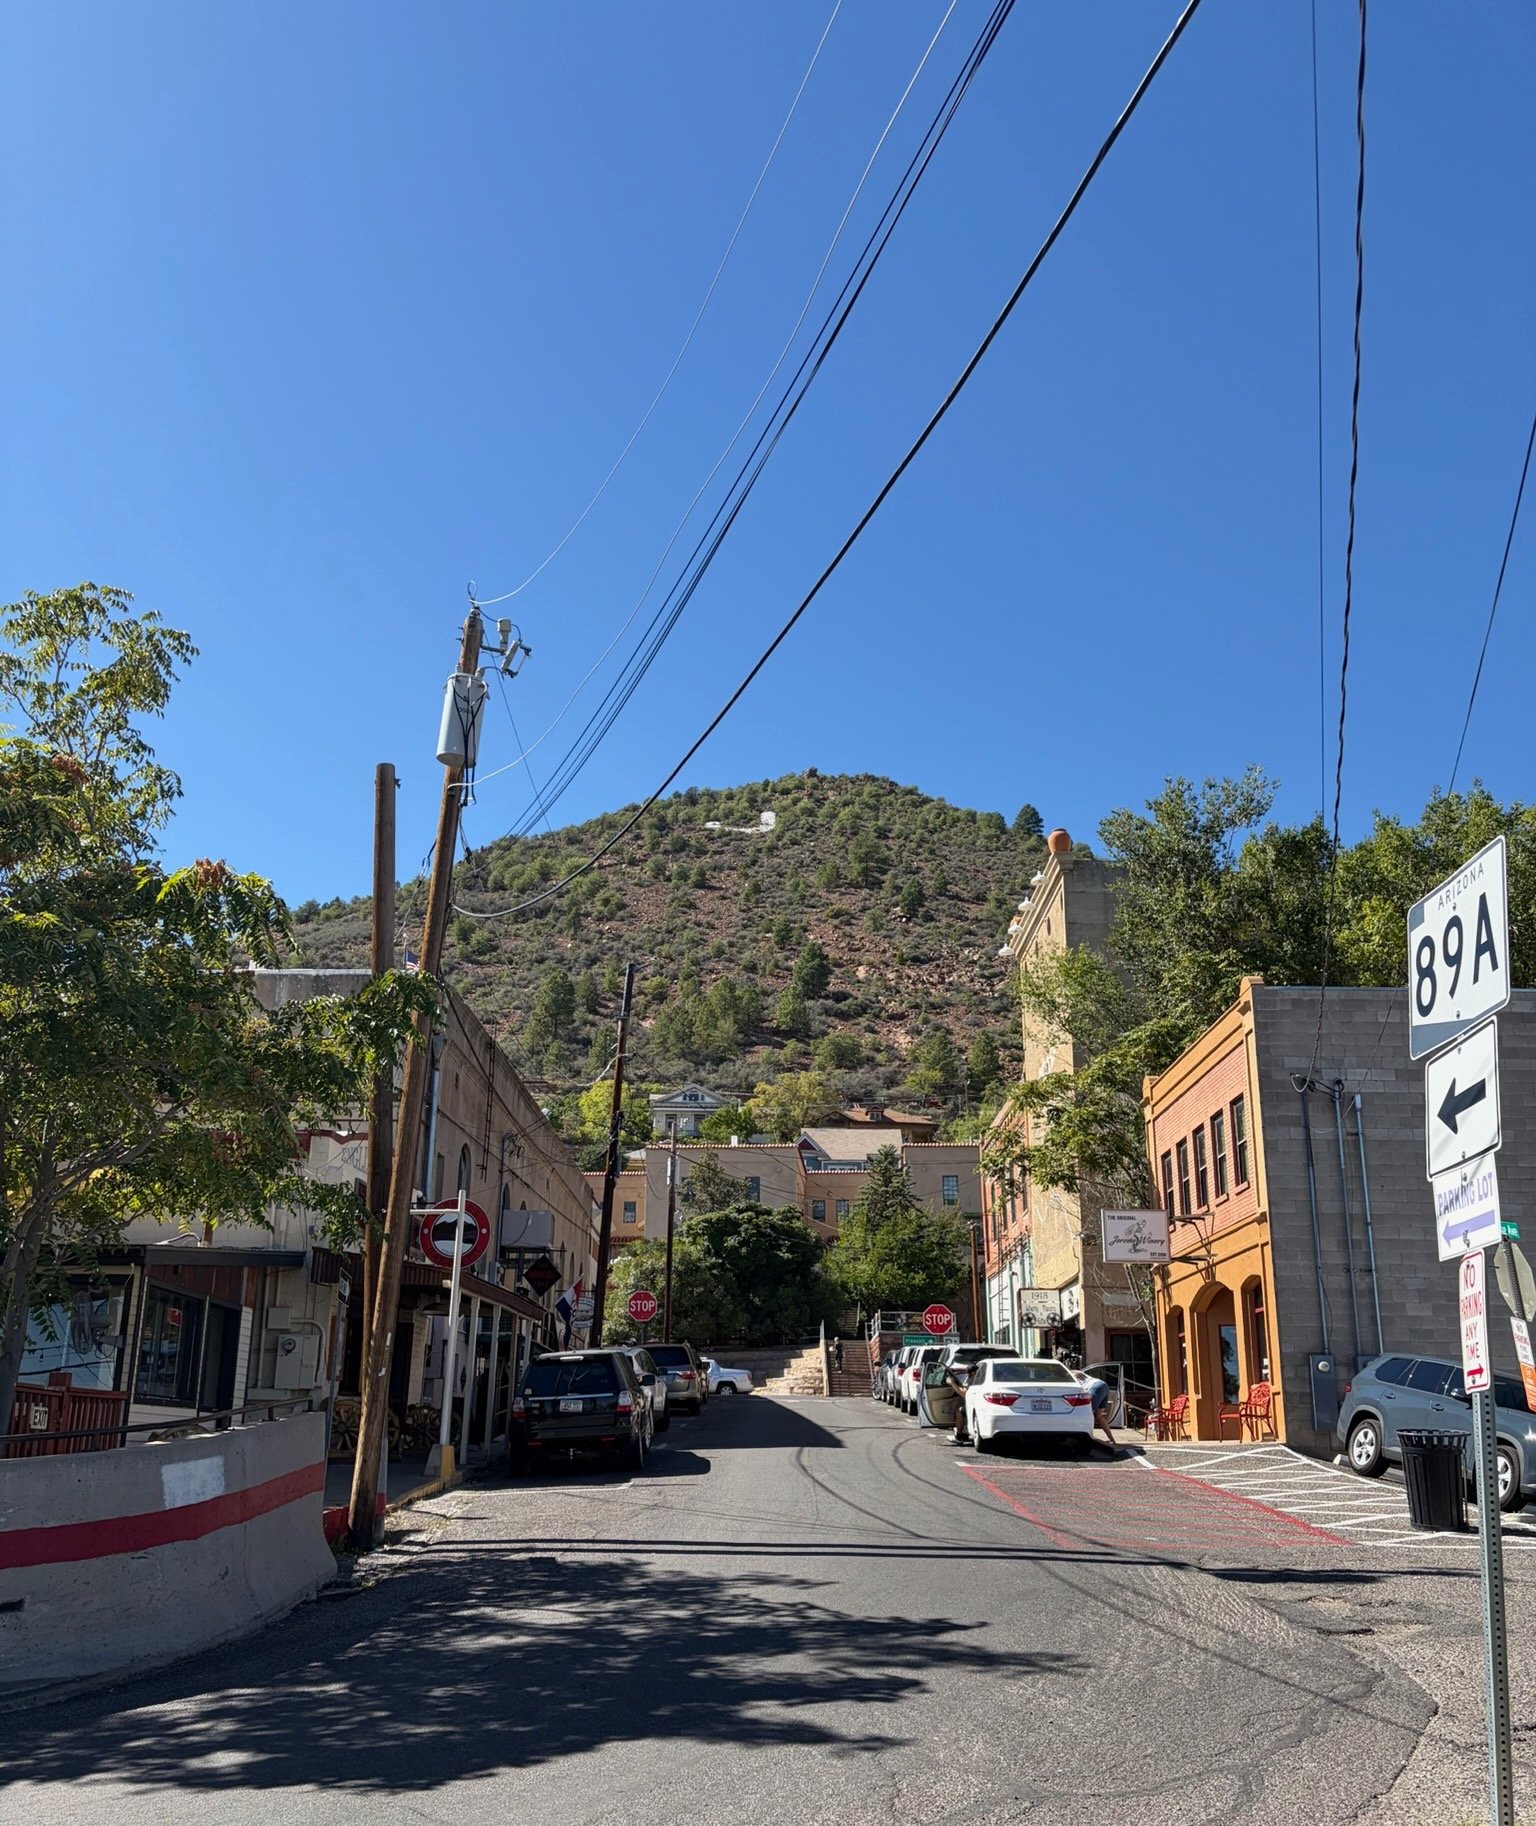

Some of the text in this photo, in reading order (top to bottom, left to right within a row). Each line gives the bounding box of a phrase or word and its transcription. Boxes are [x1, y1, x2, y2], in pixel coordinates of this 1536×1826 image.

[1437, 861, 1484, 910] ARIZONA
[1416, 892, 1498, 1018] 89A
[1437, 1171, 1493, 1217] PARKING LOT
[1138, 1235, 1165, 1246] Winery
[1463, 1263, 1476, 1291] NO
[630, 1301, 655, 1312] STOP
[1461, 1291, 1482, 1319] PARKING
[925, 1314, 950, 1325] STOP
[1465, 1321, 1478, 1342] ANY
[1466, 1342, 1480, 1360] TIME
[33, 1409, 47, 1427] EXIT
